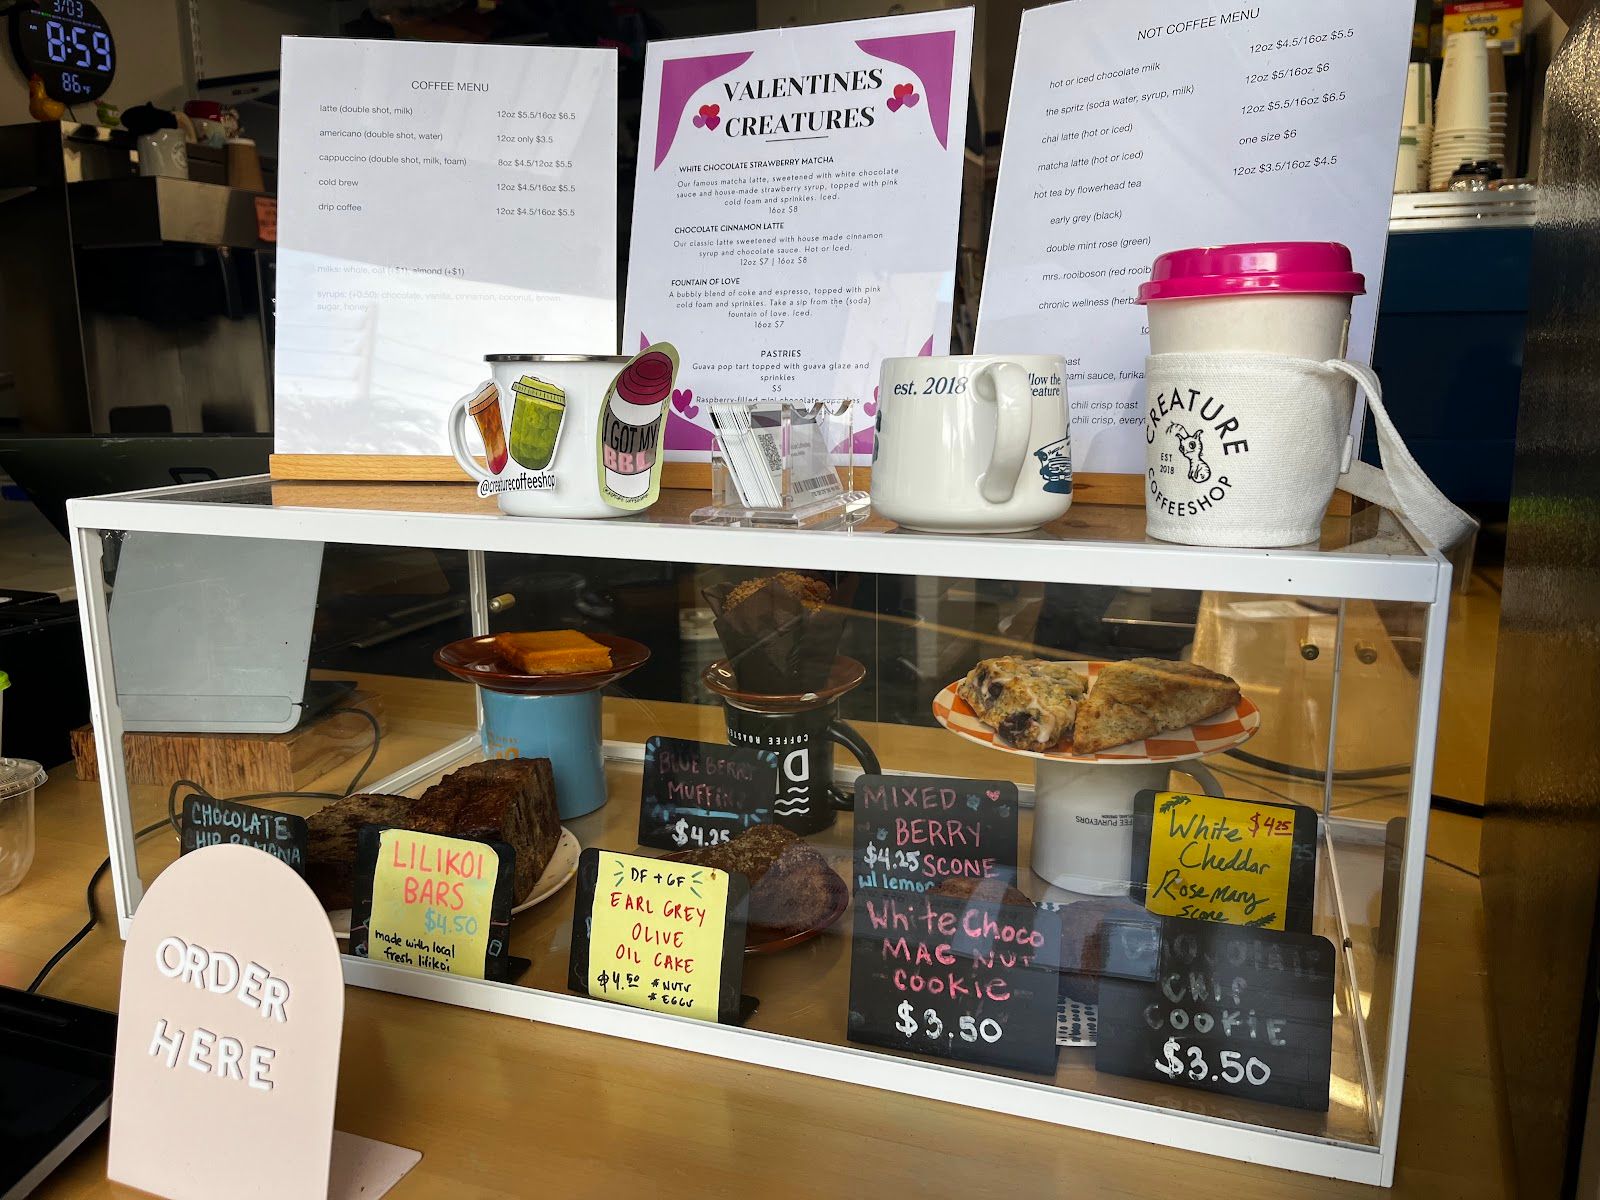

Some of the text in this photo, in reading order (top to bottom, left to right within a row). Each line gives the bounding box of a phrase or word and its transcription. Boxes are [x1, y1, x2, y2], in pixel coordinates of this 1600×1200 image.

[1137, 7, 1260, 41] NOT COFFEE MENU
[46, 21, 111, 71] 8:59
[1249, 28, 1354, 54] 12oz $4.5/16oz $5.5
[411, 80, 489, 92] COFFEE MENU
[724, 68, 882, 101] VALENTINES
[1049, 61, 1161, 89] hot or iced chocolate milk
[1245, 62, 1330, 84] 12oz $5/16oz $6
[319, 104, 413, 116] latte (double shot, milk)
[1045, 83, 1195, 117] the spritz (soda water, syrup, milk)
[496, 110, 576, 120] 12oz $5.5/16oz $6.5
[725, 106, 874, 137] CREATURES
[319, 129, 443, 141] americano (double shot, water)
[496, 134, 553, 145] 12oz only $3.5
[1238, 128, 1297, 145] one size $6
[318, 154, 467, 167] cappuccino (double shot, milk, foam)
[678, 155, 834, 173] WHITE CHOCOLATE STRAWBERRY MATCHA
[318, 177, 359, 187] cold brew
[496, 182, 576, 193] 12oz $4.5/16oz $5.5
[1033, 179, 1142, 199] hot tea by flowerhead tea
[317, 202, 362, 212] drip coffee
[768, 205, 798, 214] 16oz $8
[673, 221, 784, 234] CHOCOLATE CINNAMON LATTE
[1045, 235, 1151, 253] double mint rose (green)
[670, 277, 740, 287] FOUNTAIN OF LOVE
[691, 362, 715, 370] Guava
[717, 364, 733, 372] pop
[751, 362, 781, 371] topped
[783, 362, 800, 370] with
[802, 363, 826, 372] guava
[828, 361, 851, 371] glaze
[854, 361, 870, 369] and
[760, 349, 802, 358] PASTRIES
[894, 377, 968, 395] est. 2018
[1050, 373, 1061, 385] the
[1070, 400, 1139, 411] chili crisp toast
[604, 413, 657, 453] I GOT MY
[1146, 387, 1249, 455] CREATURE
[604, 444, 651, 473] BBL
[1159, 465, 1175, 475] 2018
[1160, 452, 1173, 462] EST
[480, 471, 555, 495] @creaturecoffeeshop
[1148, 467, 1232, 517] COFFEESHOP
[768, 733, 809, 745] COFFEE
[863, 784, 957, 810] MIXED
[191, 801, 288, 840] CHOCOLATE
[672, 818, 730, 847] $4.25
[895, 817, 981, 848] BERRY
[1170, 809, 1242, 842] White
[393, 840, 485, 880] LILIKOI
[863, 841, 1000, 879] $4.25 SCONE
[1178, 841, 1270, 875] Cheddar
[631, 867, 648, 883] DF
[667, 874, 686, 887] GF
[404, 876, 465, 911] BARS
[425, 907, 478, 935] $4.50
[610, 892, 706, 927] EARL GREY
[632, 922, 684, 948] OLIVE
[866, 899, 1045, 948] White Choco
[375, 929, 455, 959] made with local
[384, 947, 413, 965] fresh
[882, 937, 1038, 968] MAC NUT
[616, 944, 695, 973] OIL CAKE
[156, 936, 290, 1023] ORDER
[895, 1000, 1003, 1043] $3.50
[148, 1019, 275, 1090] HERE
[1154, 1036, 1271, 1085] $3.50
